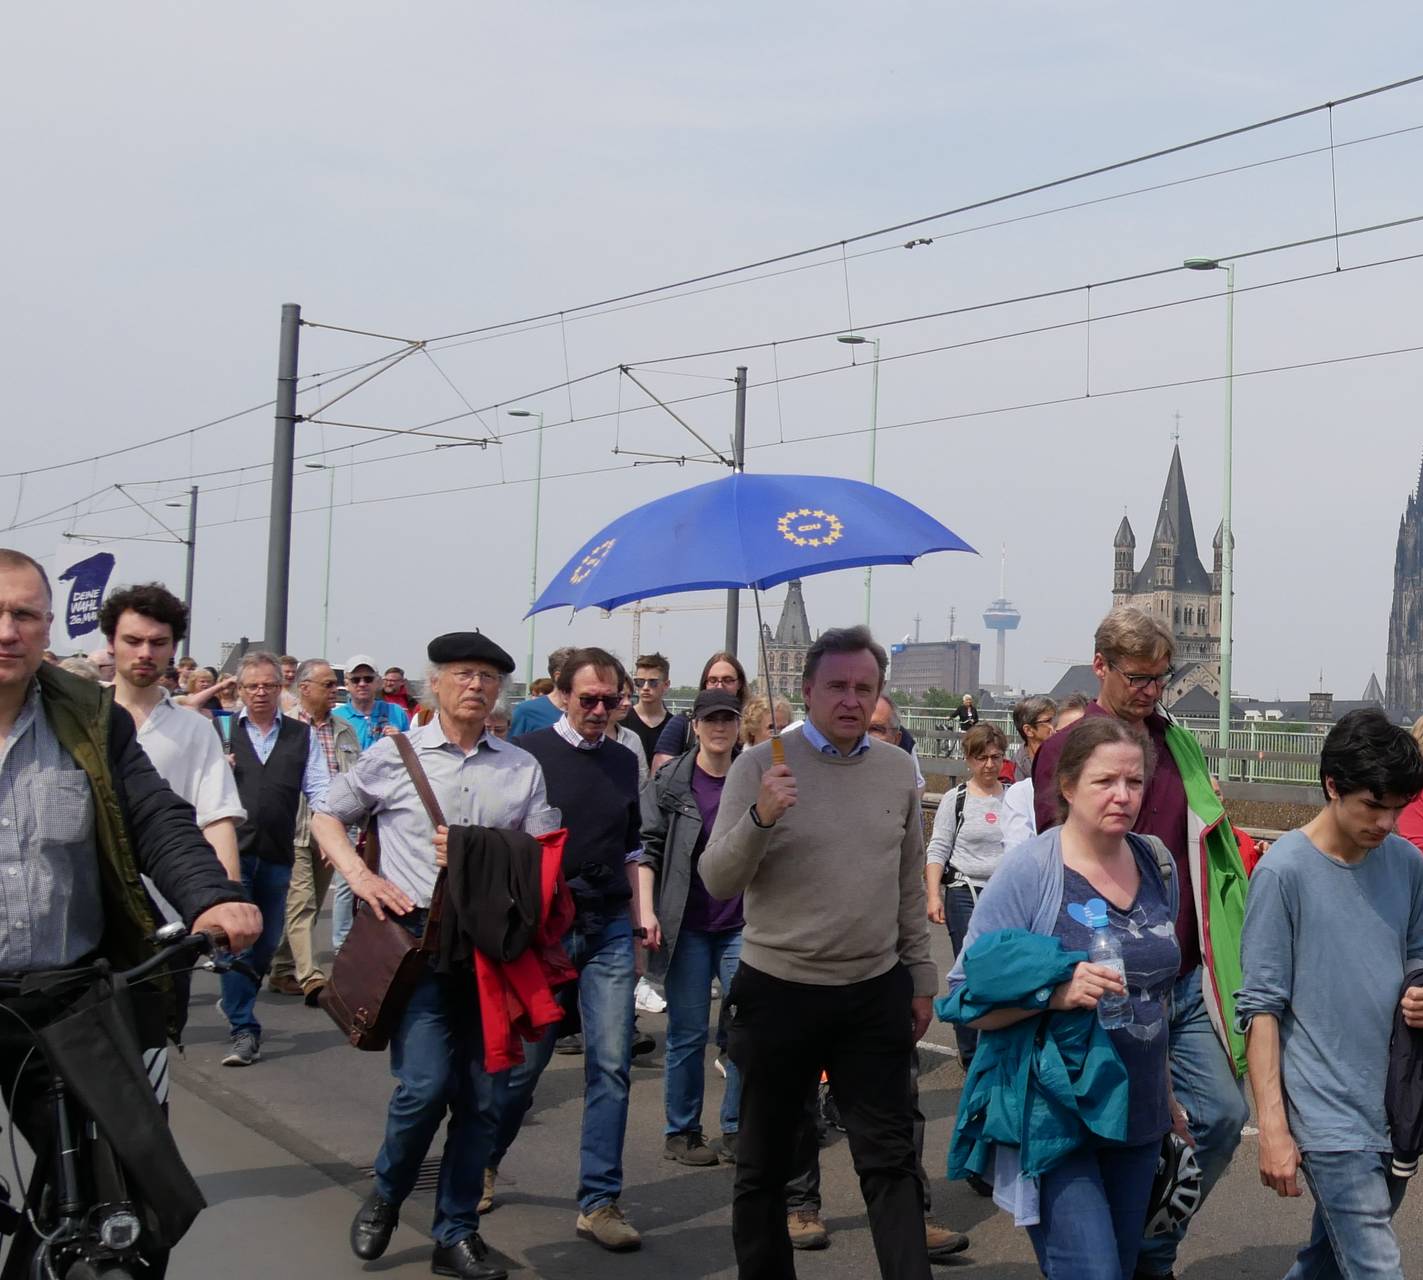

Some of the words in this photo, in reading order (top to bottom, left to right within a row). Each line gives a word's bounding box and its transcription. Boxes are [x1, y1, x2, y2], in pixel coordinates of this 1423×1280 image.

[73, 589, 101, 602] DEINE
[71, 600, 98, 614] WAHL
[69, 611, 98, 625] 26.MA
